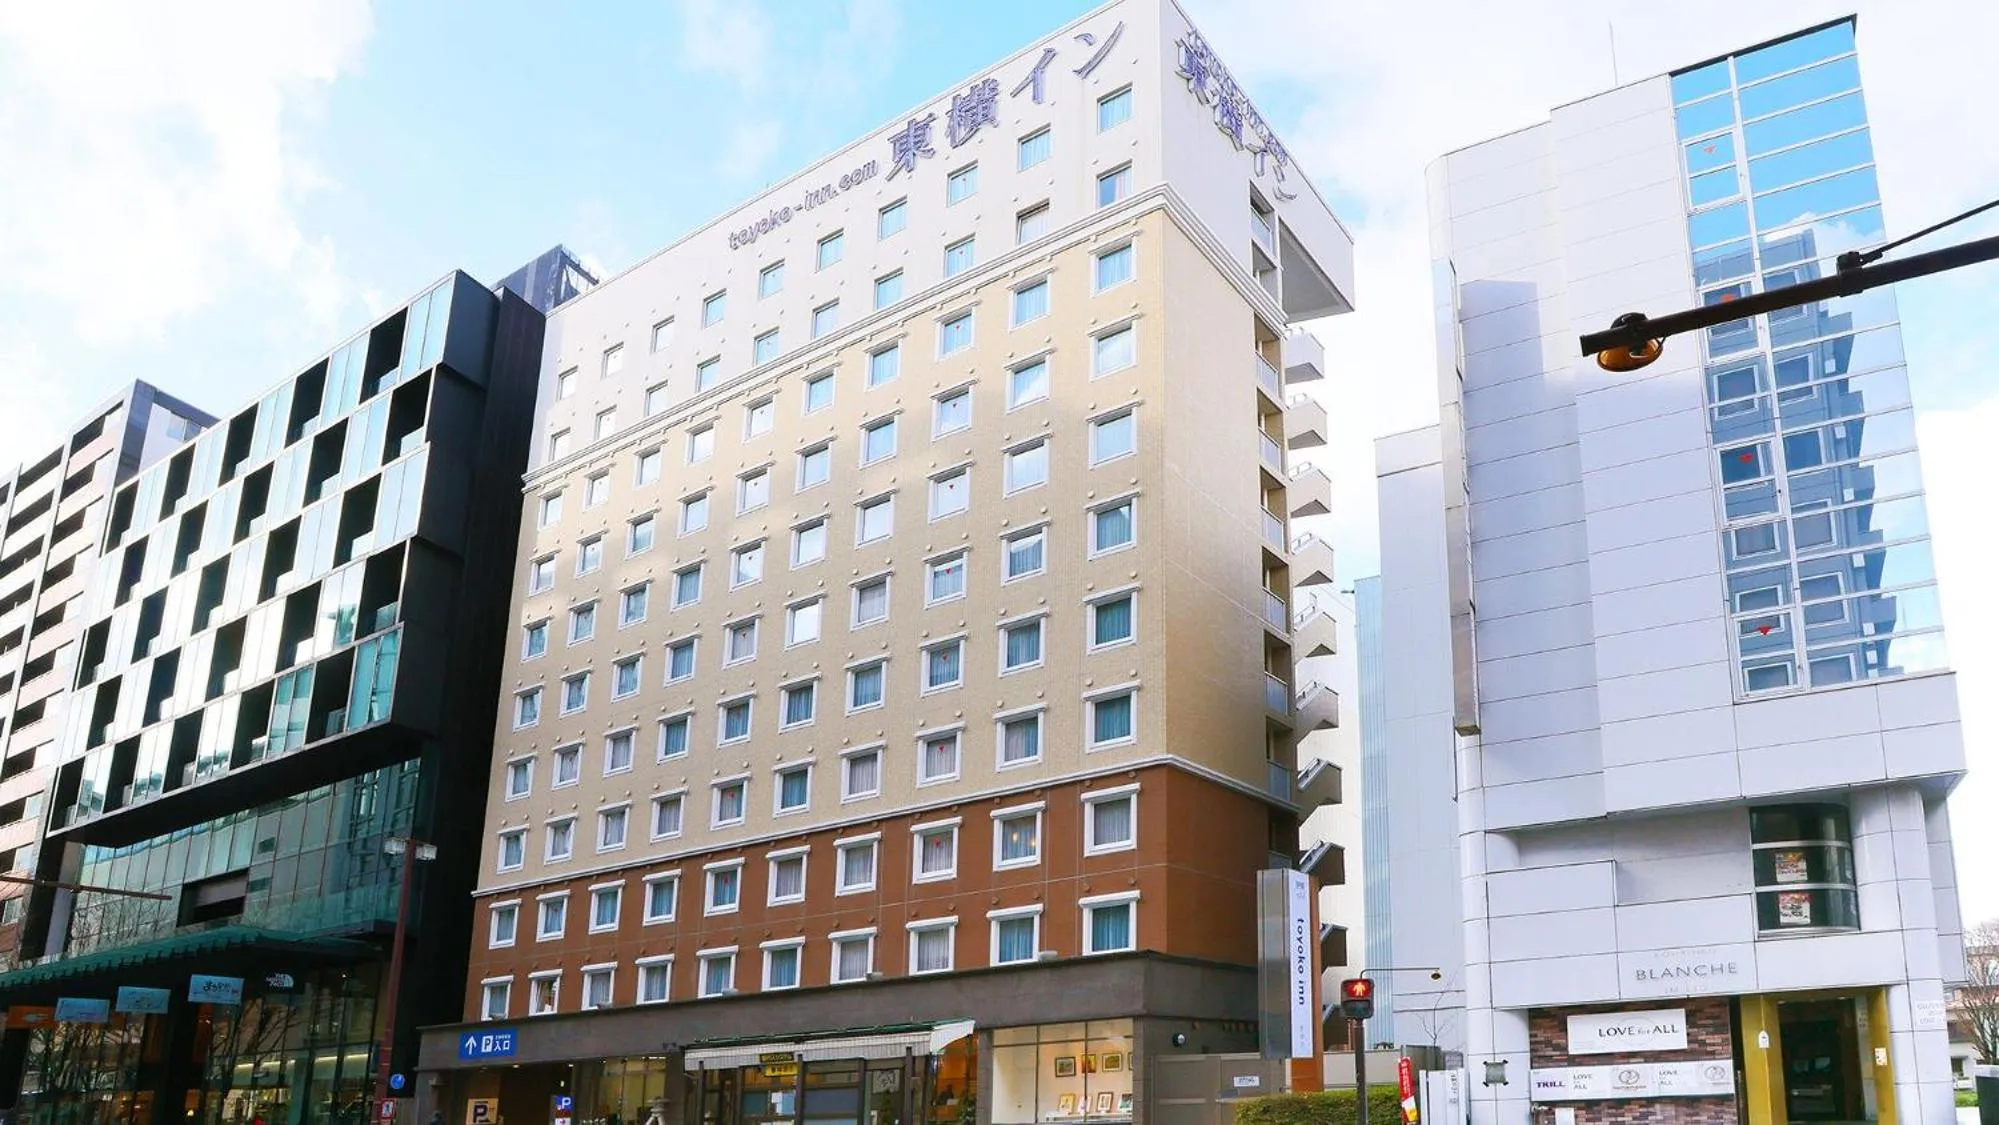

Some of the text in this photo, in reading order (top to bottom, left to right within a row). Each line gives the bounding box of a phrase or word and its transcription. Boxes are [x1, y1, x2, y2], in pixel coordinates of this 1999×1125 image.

[886, 21, 1125, 181] 東横イン
[729, 160, 879, 250] toyoko-inn.com
[1296, 918, 1306, 1005] toyoko inn
[1635, 962, 1737, 981] BLANCHE
[1598, 1027, 1635, 1037] LOVE
[1652, 1024, 1679, 1034] ALL
[494, 1040, 510, 1051] 入口
[1536, 1081, 1566, 1089] TRILL
[562, 1097, 571, 1109] P
